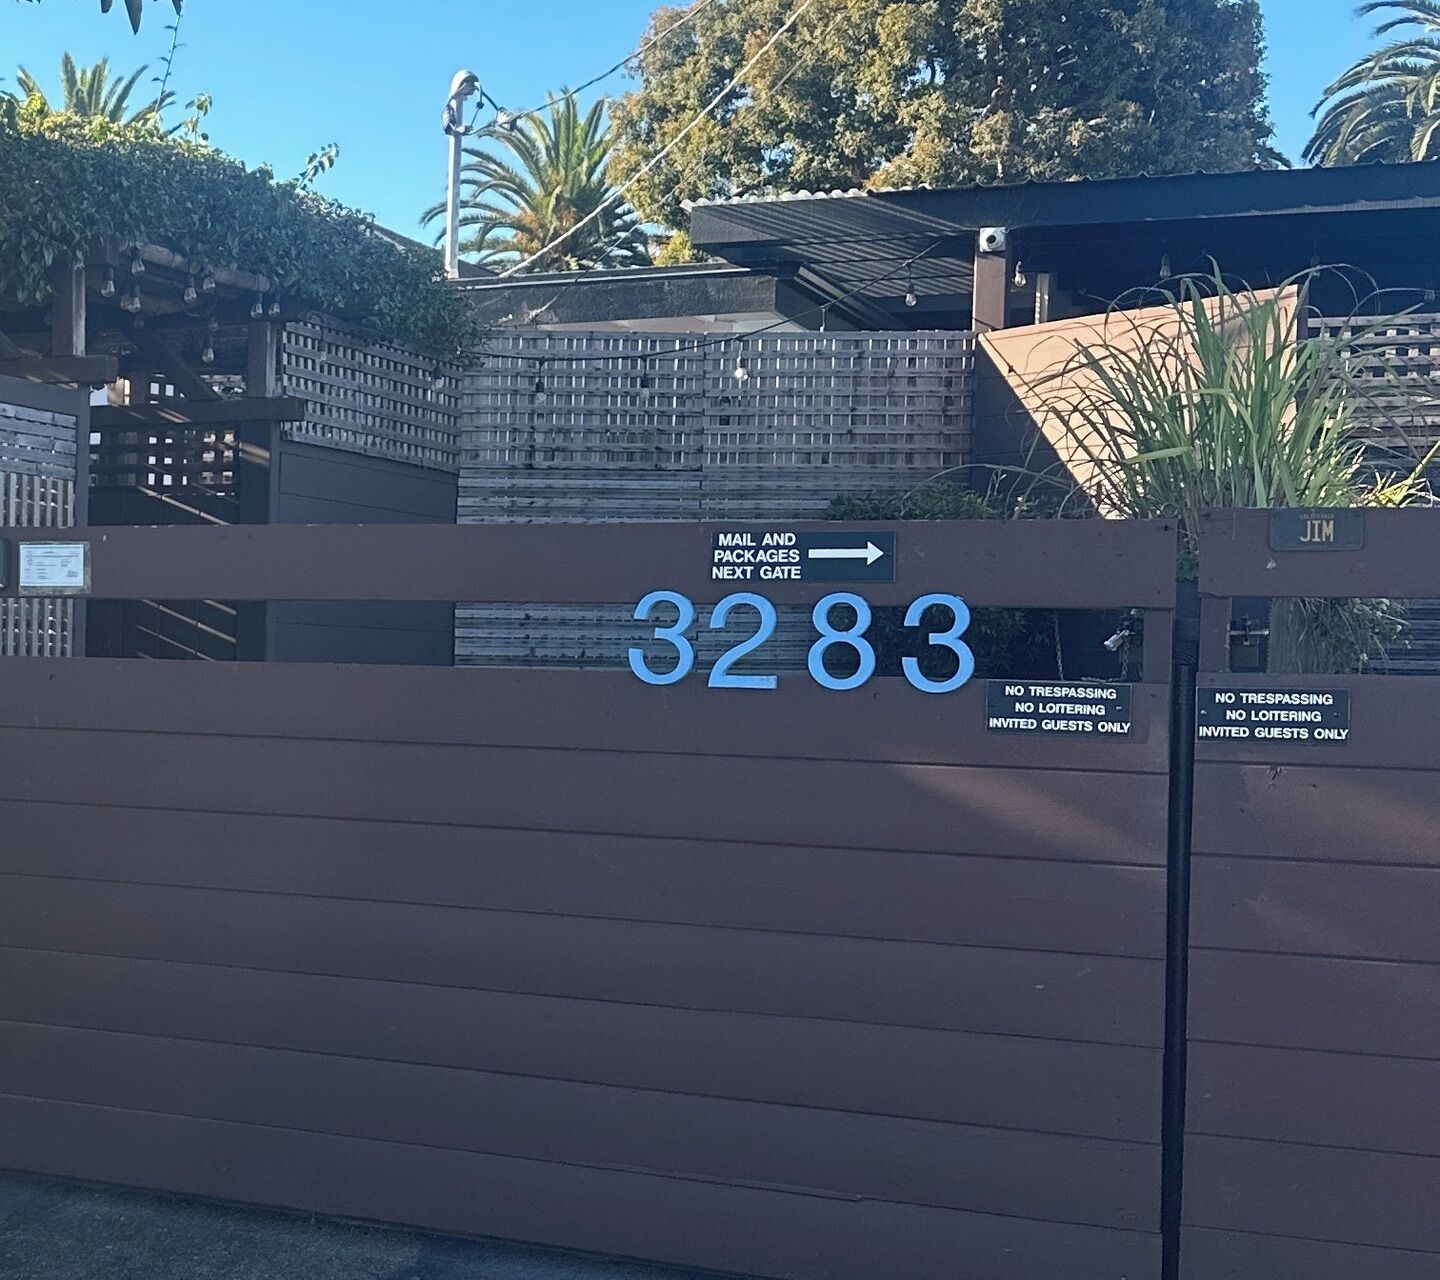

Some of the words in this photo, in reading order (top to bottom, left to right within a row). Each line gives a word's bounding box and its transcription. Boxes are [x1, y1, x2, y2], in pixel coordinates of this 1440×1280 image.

[1299, 520, 1334, 542] JIM
[718, 532, 757, 547] MAIL
[762, 532, 796, 546] AND
[713, 549, 801, 563] PACKAGES
[712, 566, 755, 580] NEXT
[759, 566, 802, 580] GATE
[628, 590, 975, 694] 3283
[1004, 685, 1025, 696] NO
[1028, 686, 1117, 699] TRESPASSING
[1215, 692, 1236, 704] NO
[1239, 692, 1334, 706] TRESPASSING
[1014, 702, 1035, 713] NO
[1038, 703, 1106, 715] LOITERING
[1225, 709, 1247, 721] NO
[1251, 710, 1322, 722] LOITERING
[989, 717, 1038, 730] INVITED
[1041, 719, 1093, 731] GUESTS
[1097, 721, 1131, 734] ONLY
[1198, 726, 1250, 738] INVITED
[1254, 727, 1309, 739] GUESTS
[1313, 728, 1350, 740] ONLY
